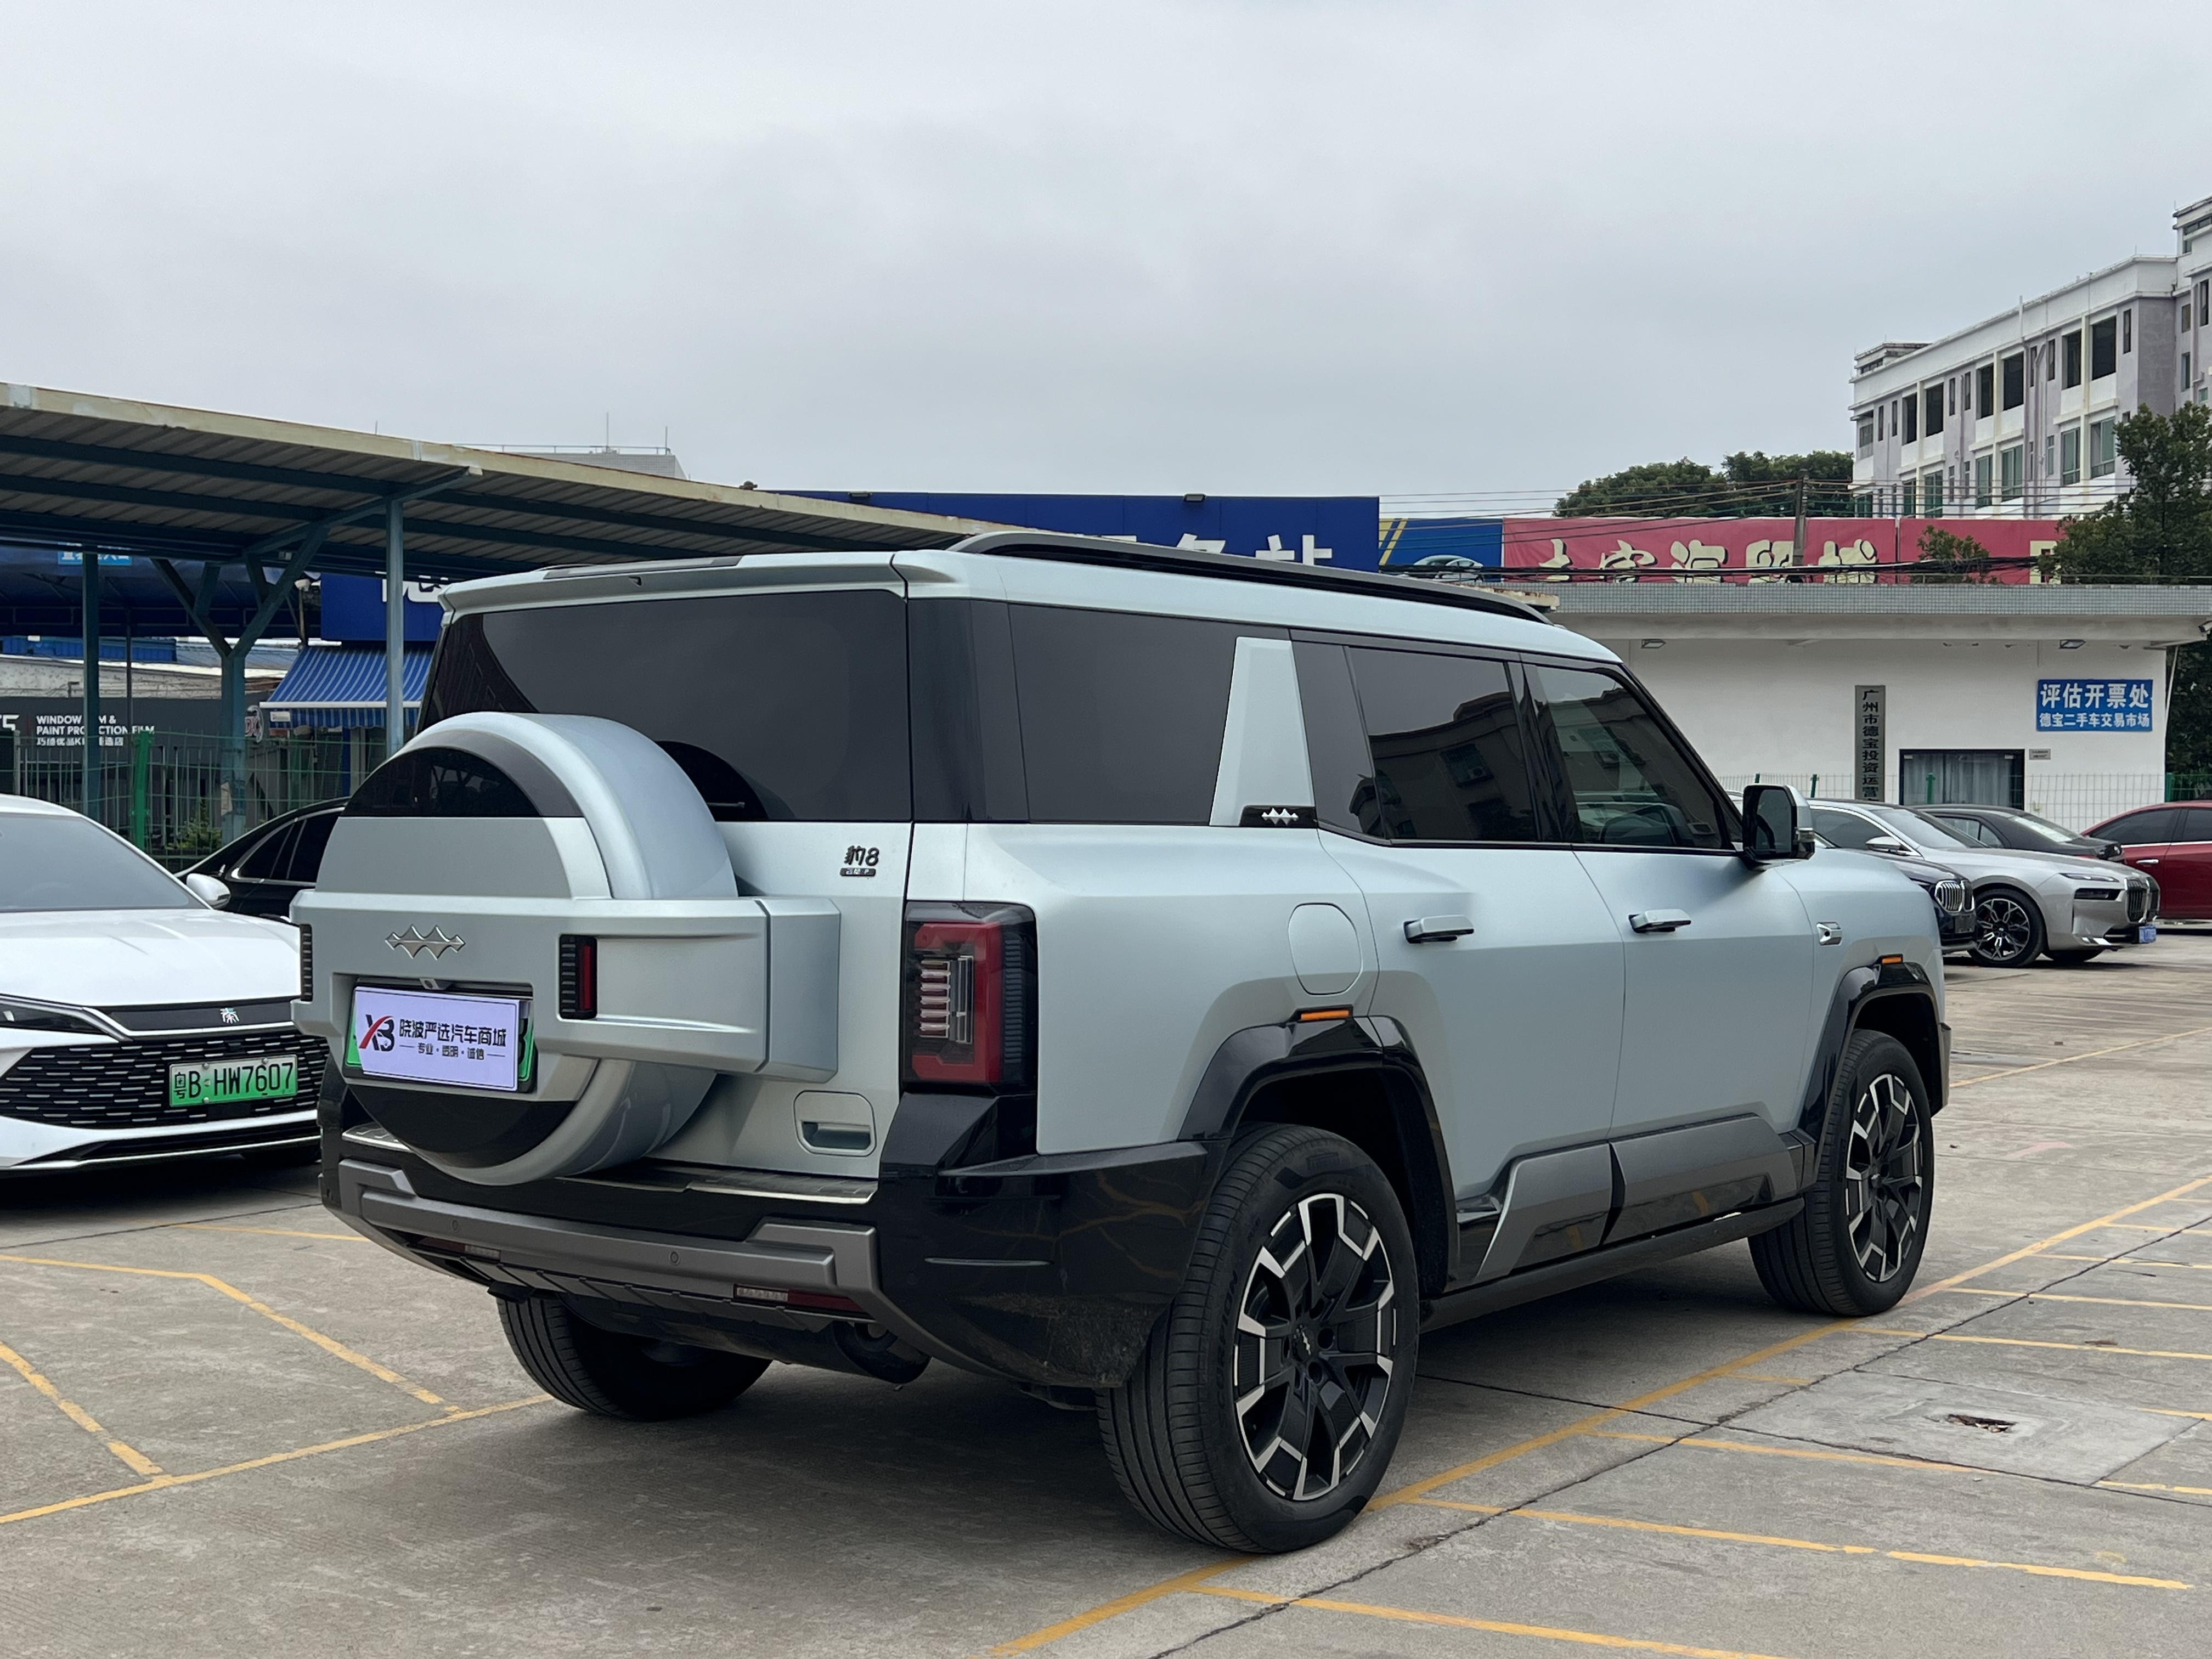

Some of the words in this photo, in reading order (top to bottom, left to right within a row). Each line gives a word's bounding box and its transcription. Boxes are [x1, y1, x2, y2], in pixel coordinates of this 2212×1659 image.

[2040, 683, 2149, 709] 评估开票处
[36, 715, 82, 724] WINDOW
[109, 715, 116, 724] &
[2039, 713, 2149, 727] 德宝二手车交易市场
[36, 726, 65, 735] PAINT
[67, 726, 128, 735] PROCTION
[1863, 690, 1879, 801] 广州市德宝投资运营
[843, 845, 879, 866] 豹8
[399, 1019, 506, 1047] 晓波严选汽车商城
